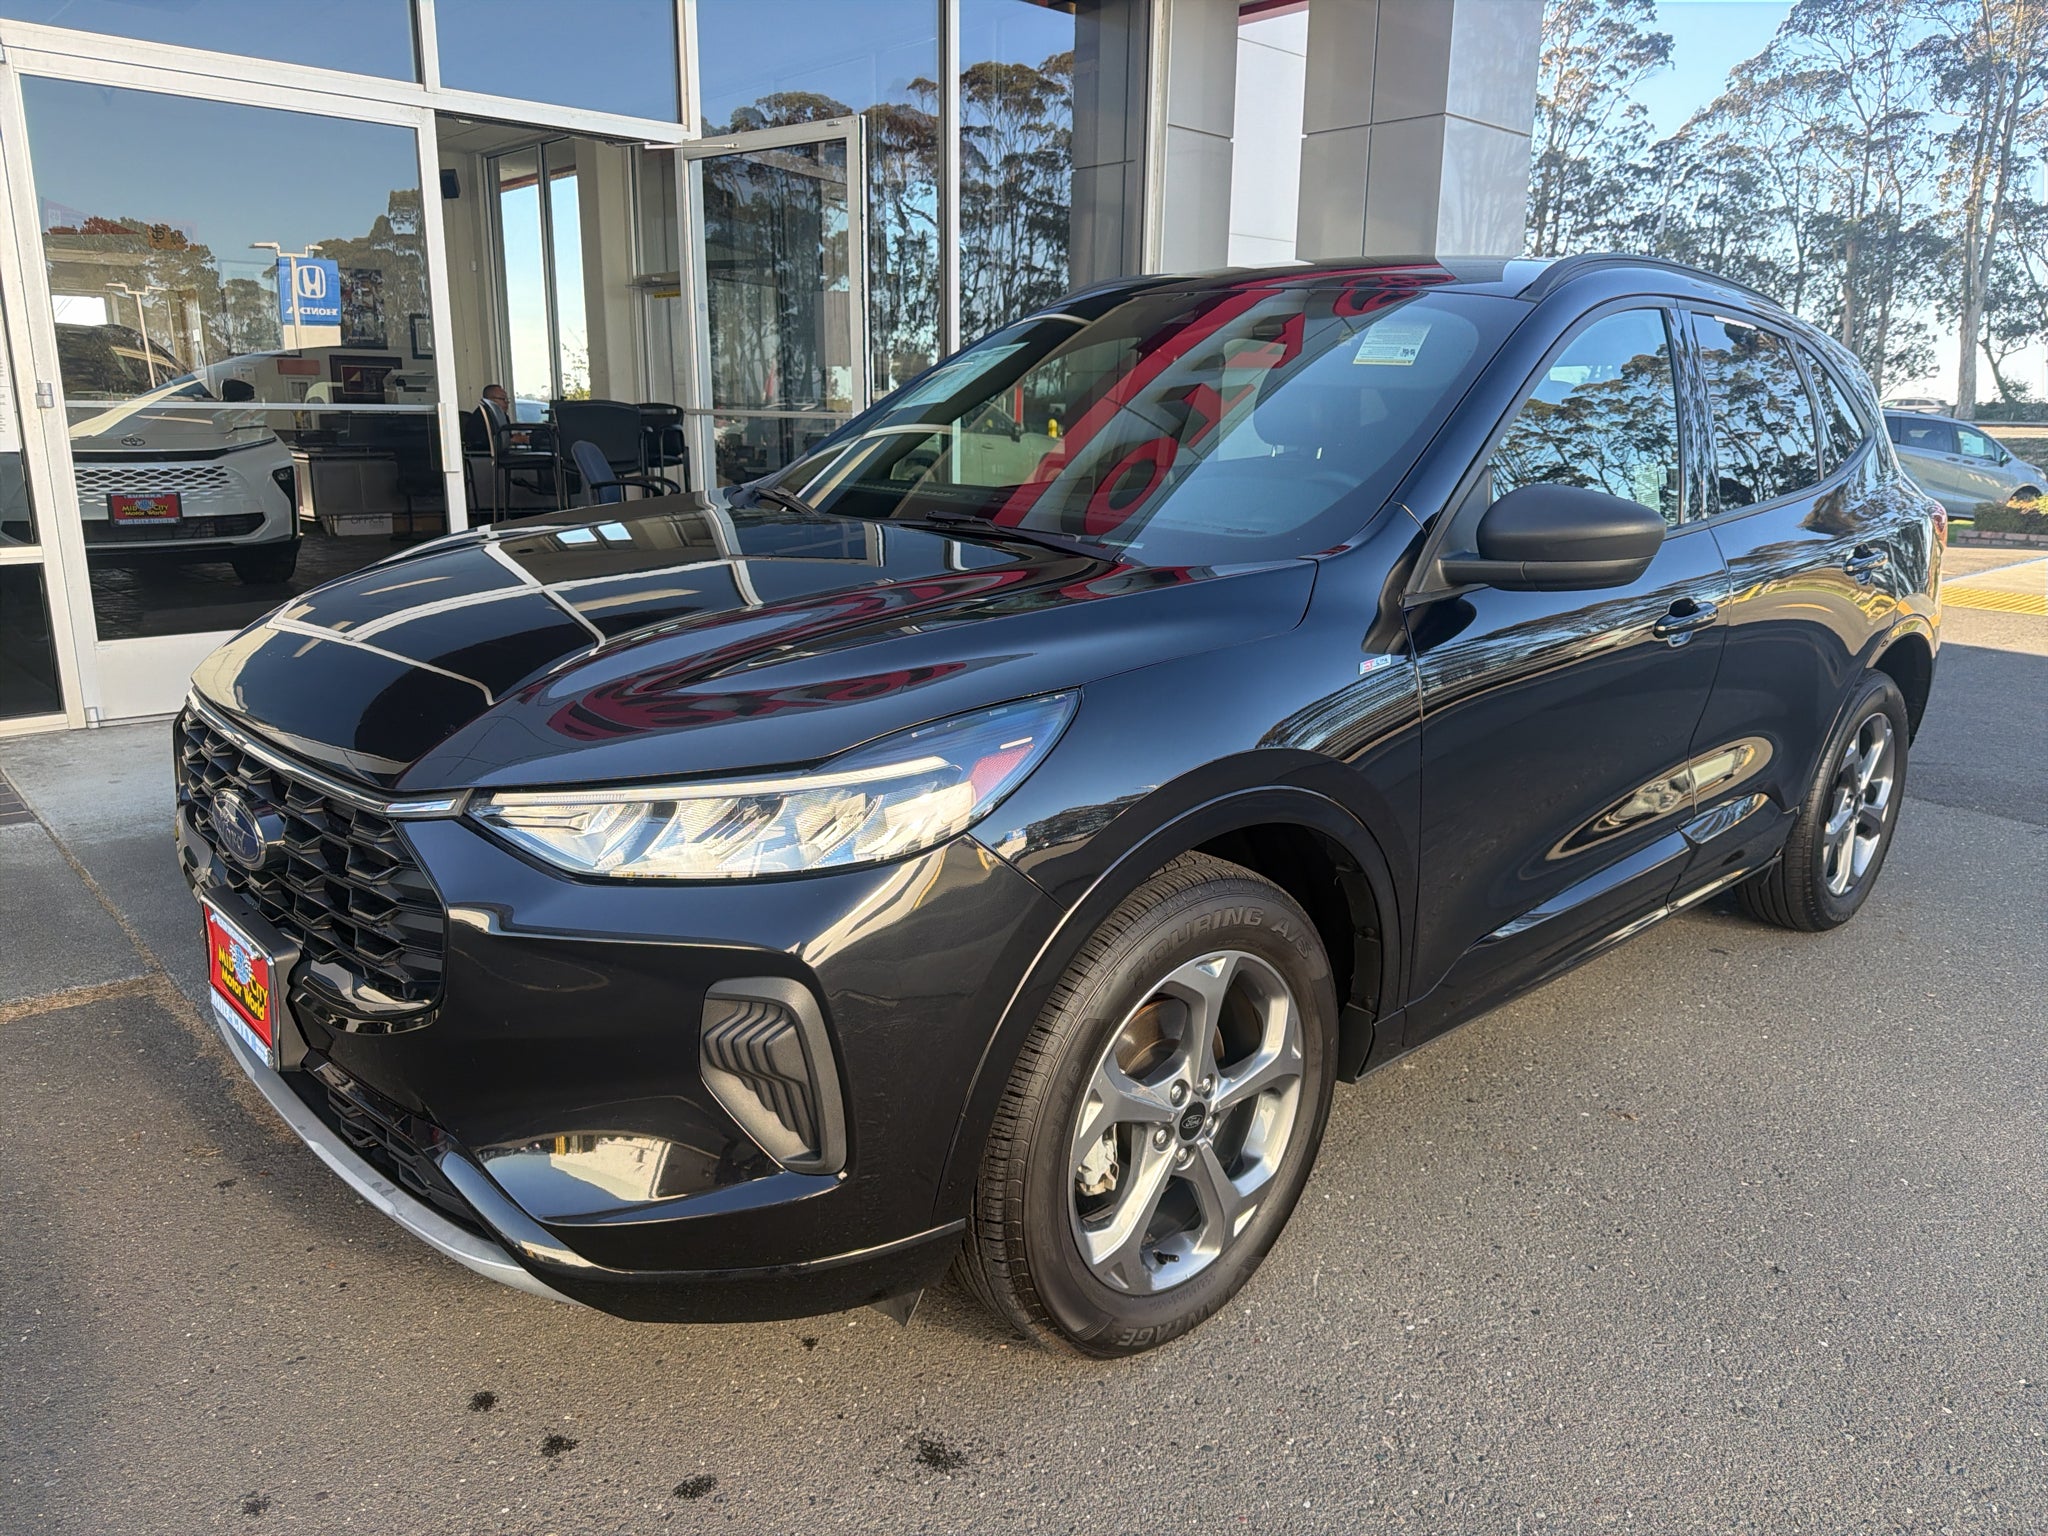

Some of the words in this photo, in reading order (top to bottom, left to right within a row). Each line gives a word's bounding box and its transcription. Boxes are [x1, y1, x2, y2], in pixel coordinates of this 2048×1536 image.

[122, 504, 138, 512] MID
[1127, 904, 1265, 986] TOURING
[218, 944, 236, 973] MID
[250, 975, 269, 1007] CITY
[221, 966, 243, 997] Motor
[243, 985, 266, 1021] World
